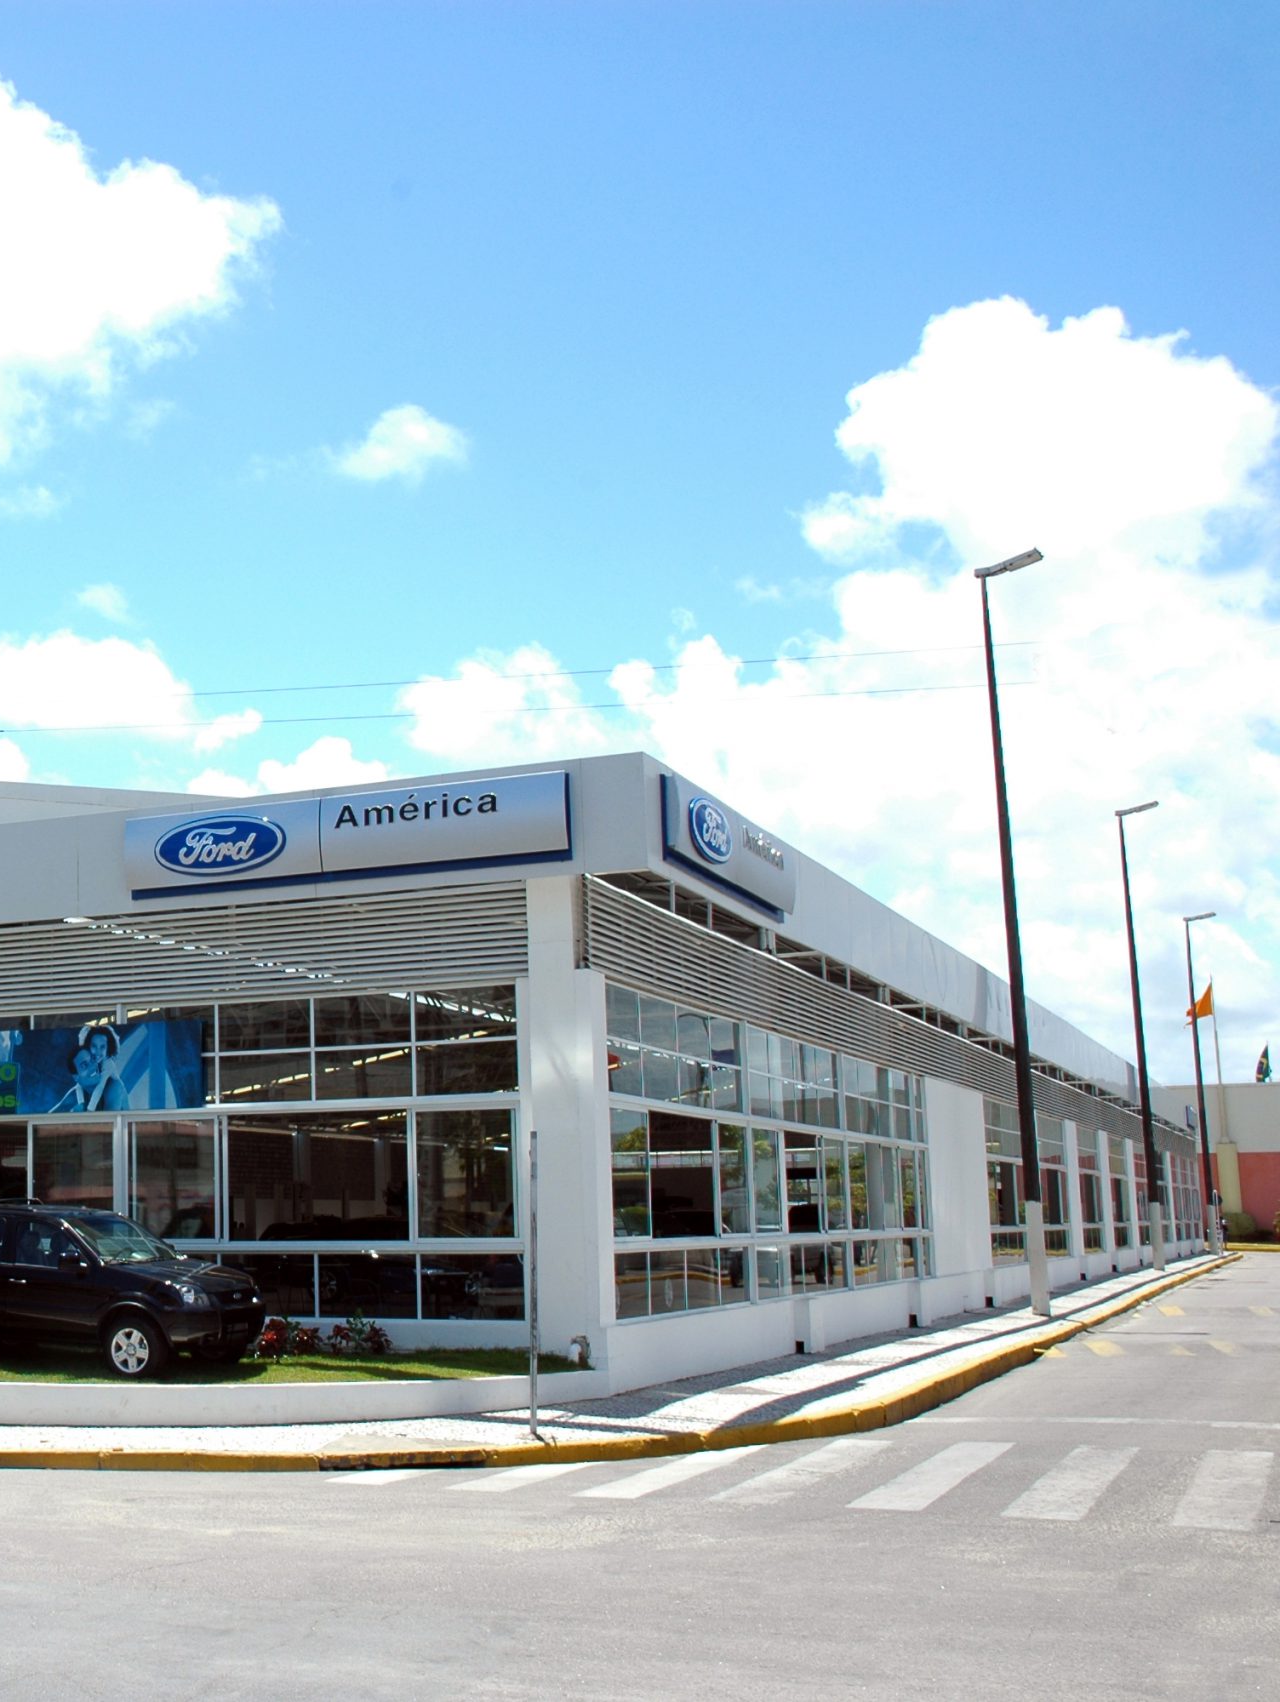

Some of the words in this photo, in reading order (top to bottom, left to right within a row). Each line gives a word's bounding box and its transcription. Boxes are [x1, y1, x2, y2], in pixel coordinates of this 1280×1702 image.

[334, 792, 499, 829] América
[702, 807, 728, 853] Ford
[178, 826, 258, 866] Ford
